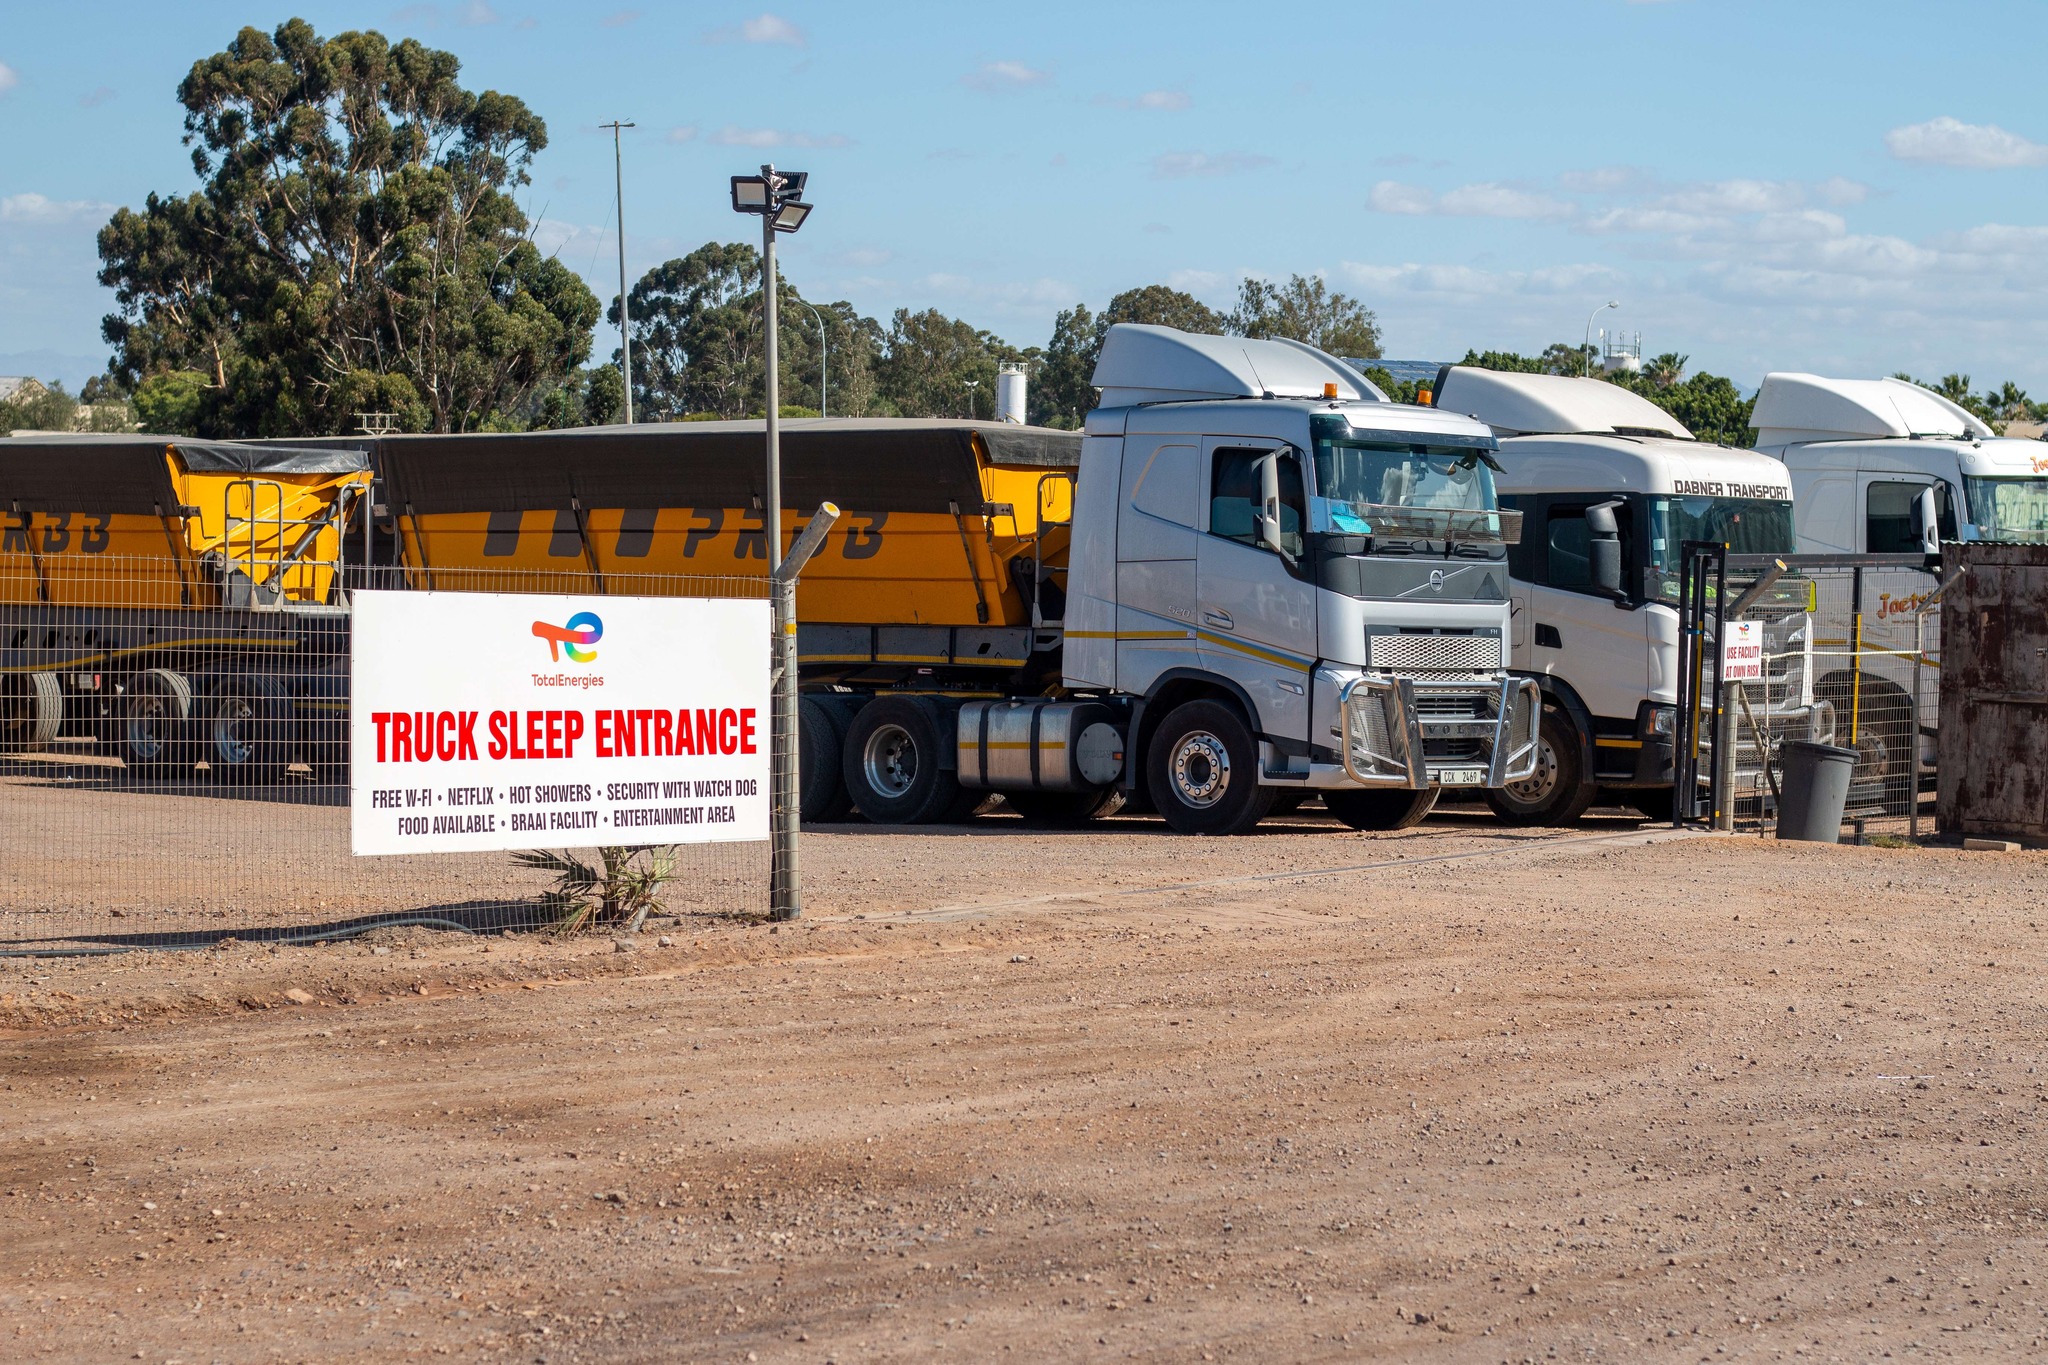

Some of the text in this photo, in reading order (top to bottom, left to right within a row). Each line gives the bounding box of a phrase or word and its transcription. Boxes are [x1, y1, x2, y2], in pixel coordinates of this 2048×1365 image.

[1674, 480, 1788, 499] DABNER TRANSPORT
[1726, 645, 1760, 659] USE FACILITY
[1725, 664, 1760, 678] AT OWN RISK
[531, 673, 604, 690] TotalEnergies
[371, 708, 757, 763] TRUCK SLEEP ENTRANCE
[1444, 772, 1477, 783] CCK 2469
[372, 779, 757, 808] FREE W-FI NETFLIX HOT SHOWERS SECURITY WITH WATCH DOG
[398, 805, 736, 835] FOOD AVAILABLE BRAAI FACILITY ENTERTAINMENT AREA
